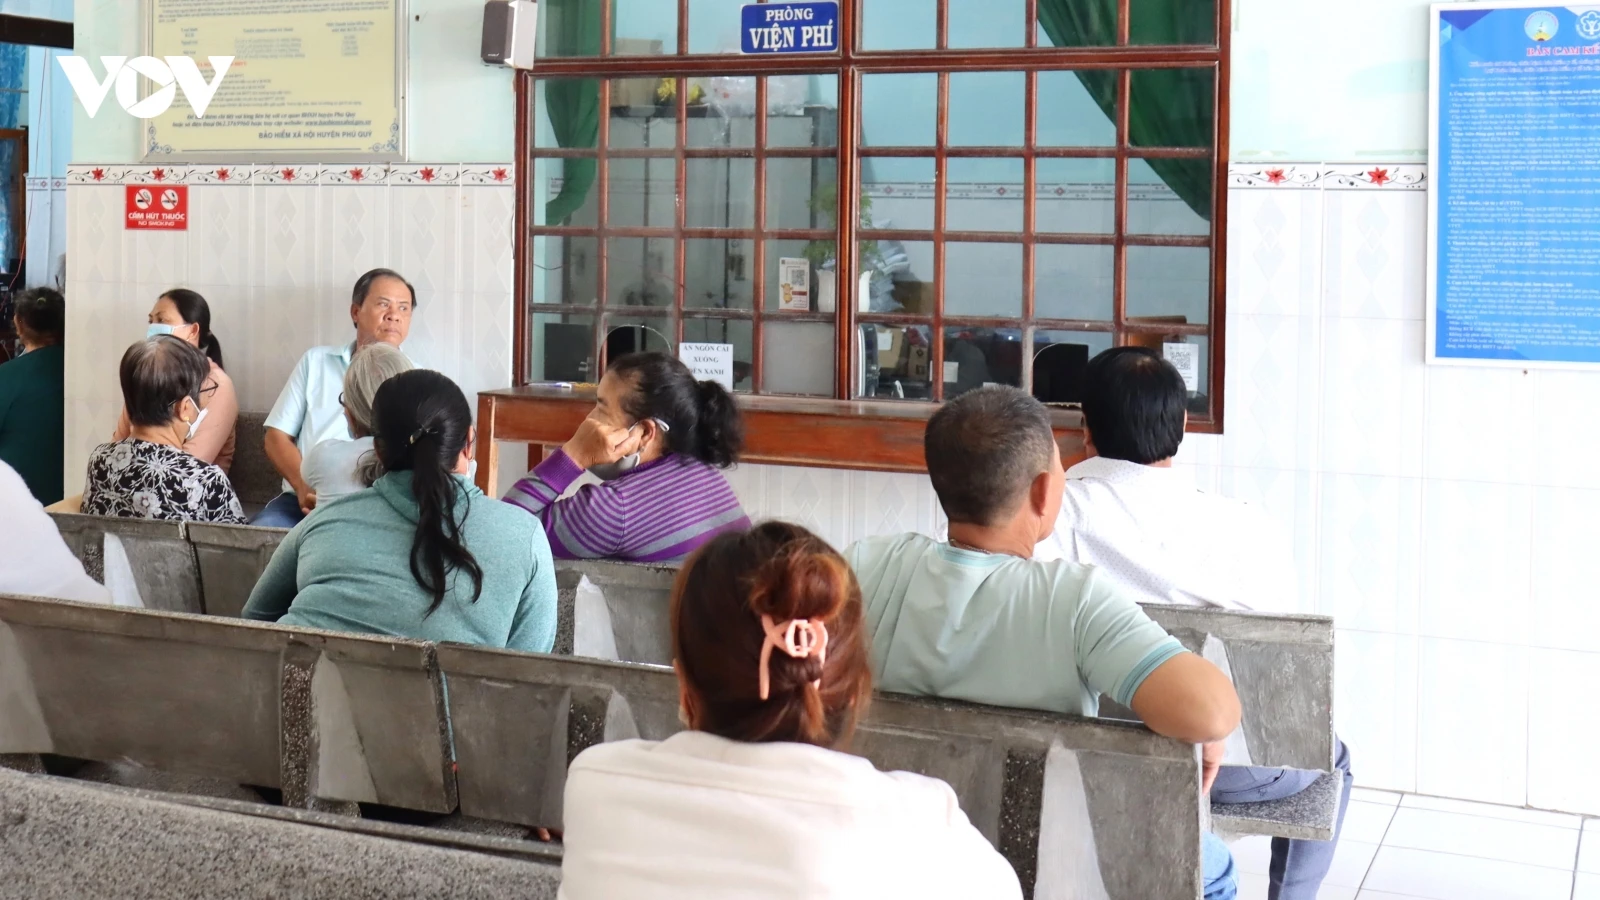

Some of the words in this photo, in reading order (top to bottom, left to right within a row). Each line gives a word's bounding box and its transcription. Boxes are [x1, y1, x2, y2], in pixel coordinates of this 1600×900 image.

[765, 5, 814, 21] PHÒNG
[749, 22, 795, 52] VIỆN
[801, 18, 833, 47] PHÍ
[1526, 45, 1551, 56] BẢN
[1553, 46, 1580, 56] CAM
[1582, 42, 1600, 55] KẾ
[258, 130, 273, 139] BẢO
[274, 128, 291, 138] HIỂM
[341, 130, 356, 138] PHÚ
[128, 210, 145, 220] CẤM
[145, 211, 160, 220] HÚT
[161, 211, 185, 220] THUỐC
[704, 368, 724, 376] XANH
